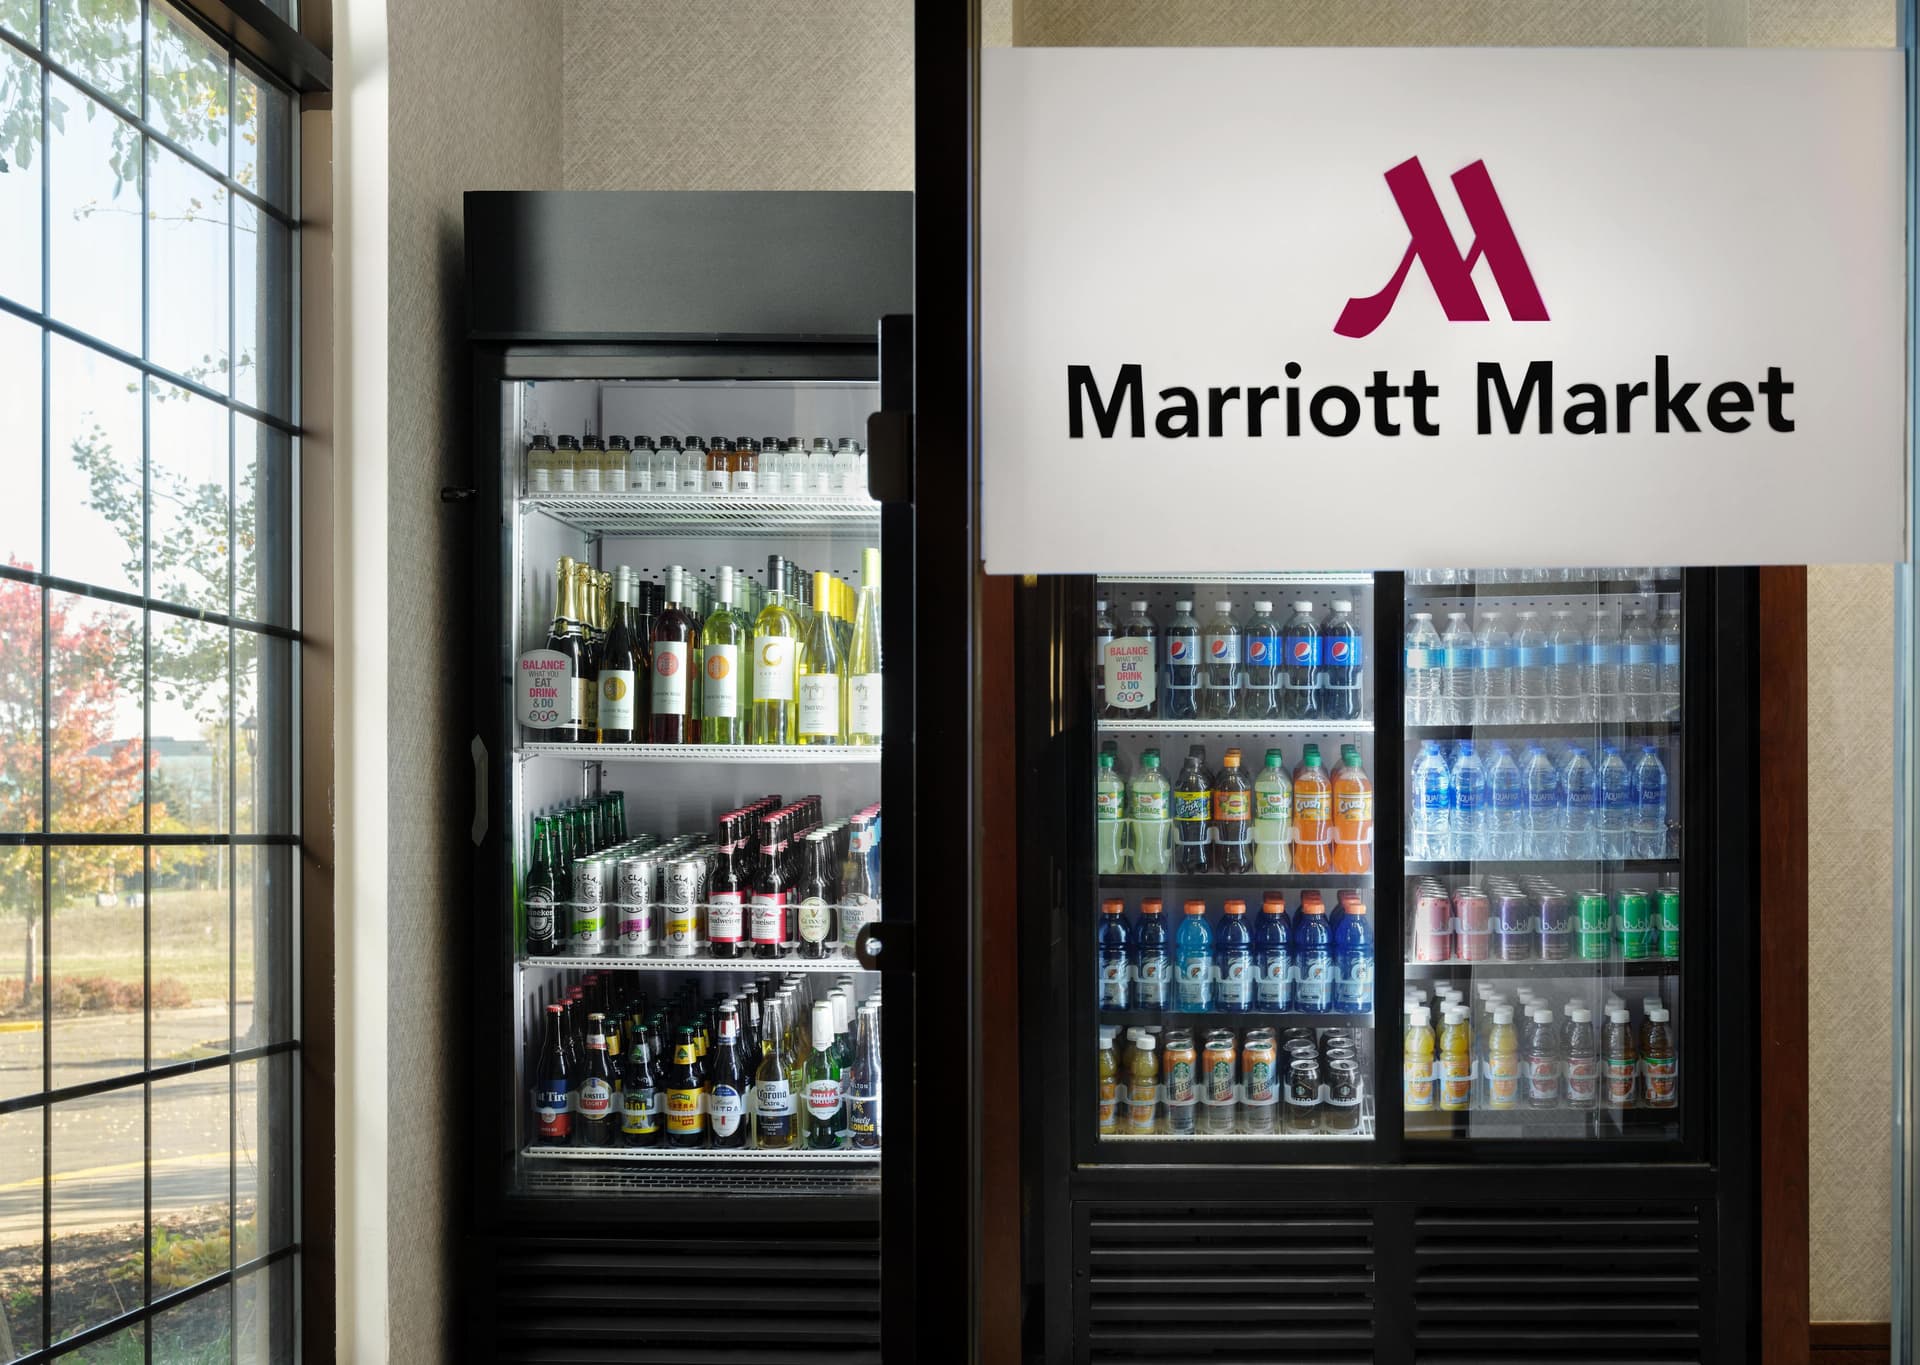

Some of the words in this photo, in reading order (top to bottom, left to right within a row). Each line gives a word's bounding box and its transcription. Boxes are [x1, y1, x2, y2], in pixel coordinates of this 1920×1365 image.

[1067, 361, 1440, 439] Marriott
[1476, 355, 1796, 436] Market
[1110, 646, 1149, 656] BALANCE
[522, 660, 566, 670] BALANCE
[1121, 662, 1136, 672] EAT
[528, 670, 546, 678] WHAT
[1117, 671, 1143, 680] DRINK
[534, 678, 552, 687] EAT
[1120, 681, 1127, 690] &
[1128, 681, 1139, 689] DO
[529, 688, 558, 697] DRINK
[533, 699, 540, 708] &
[541, 699, 554, 708] DO
[1296, 800, 1320, 813] Crush
[757, 1088, 787, 1101] Corona
